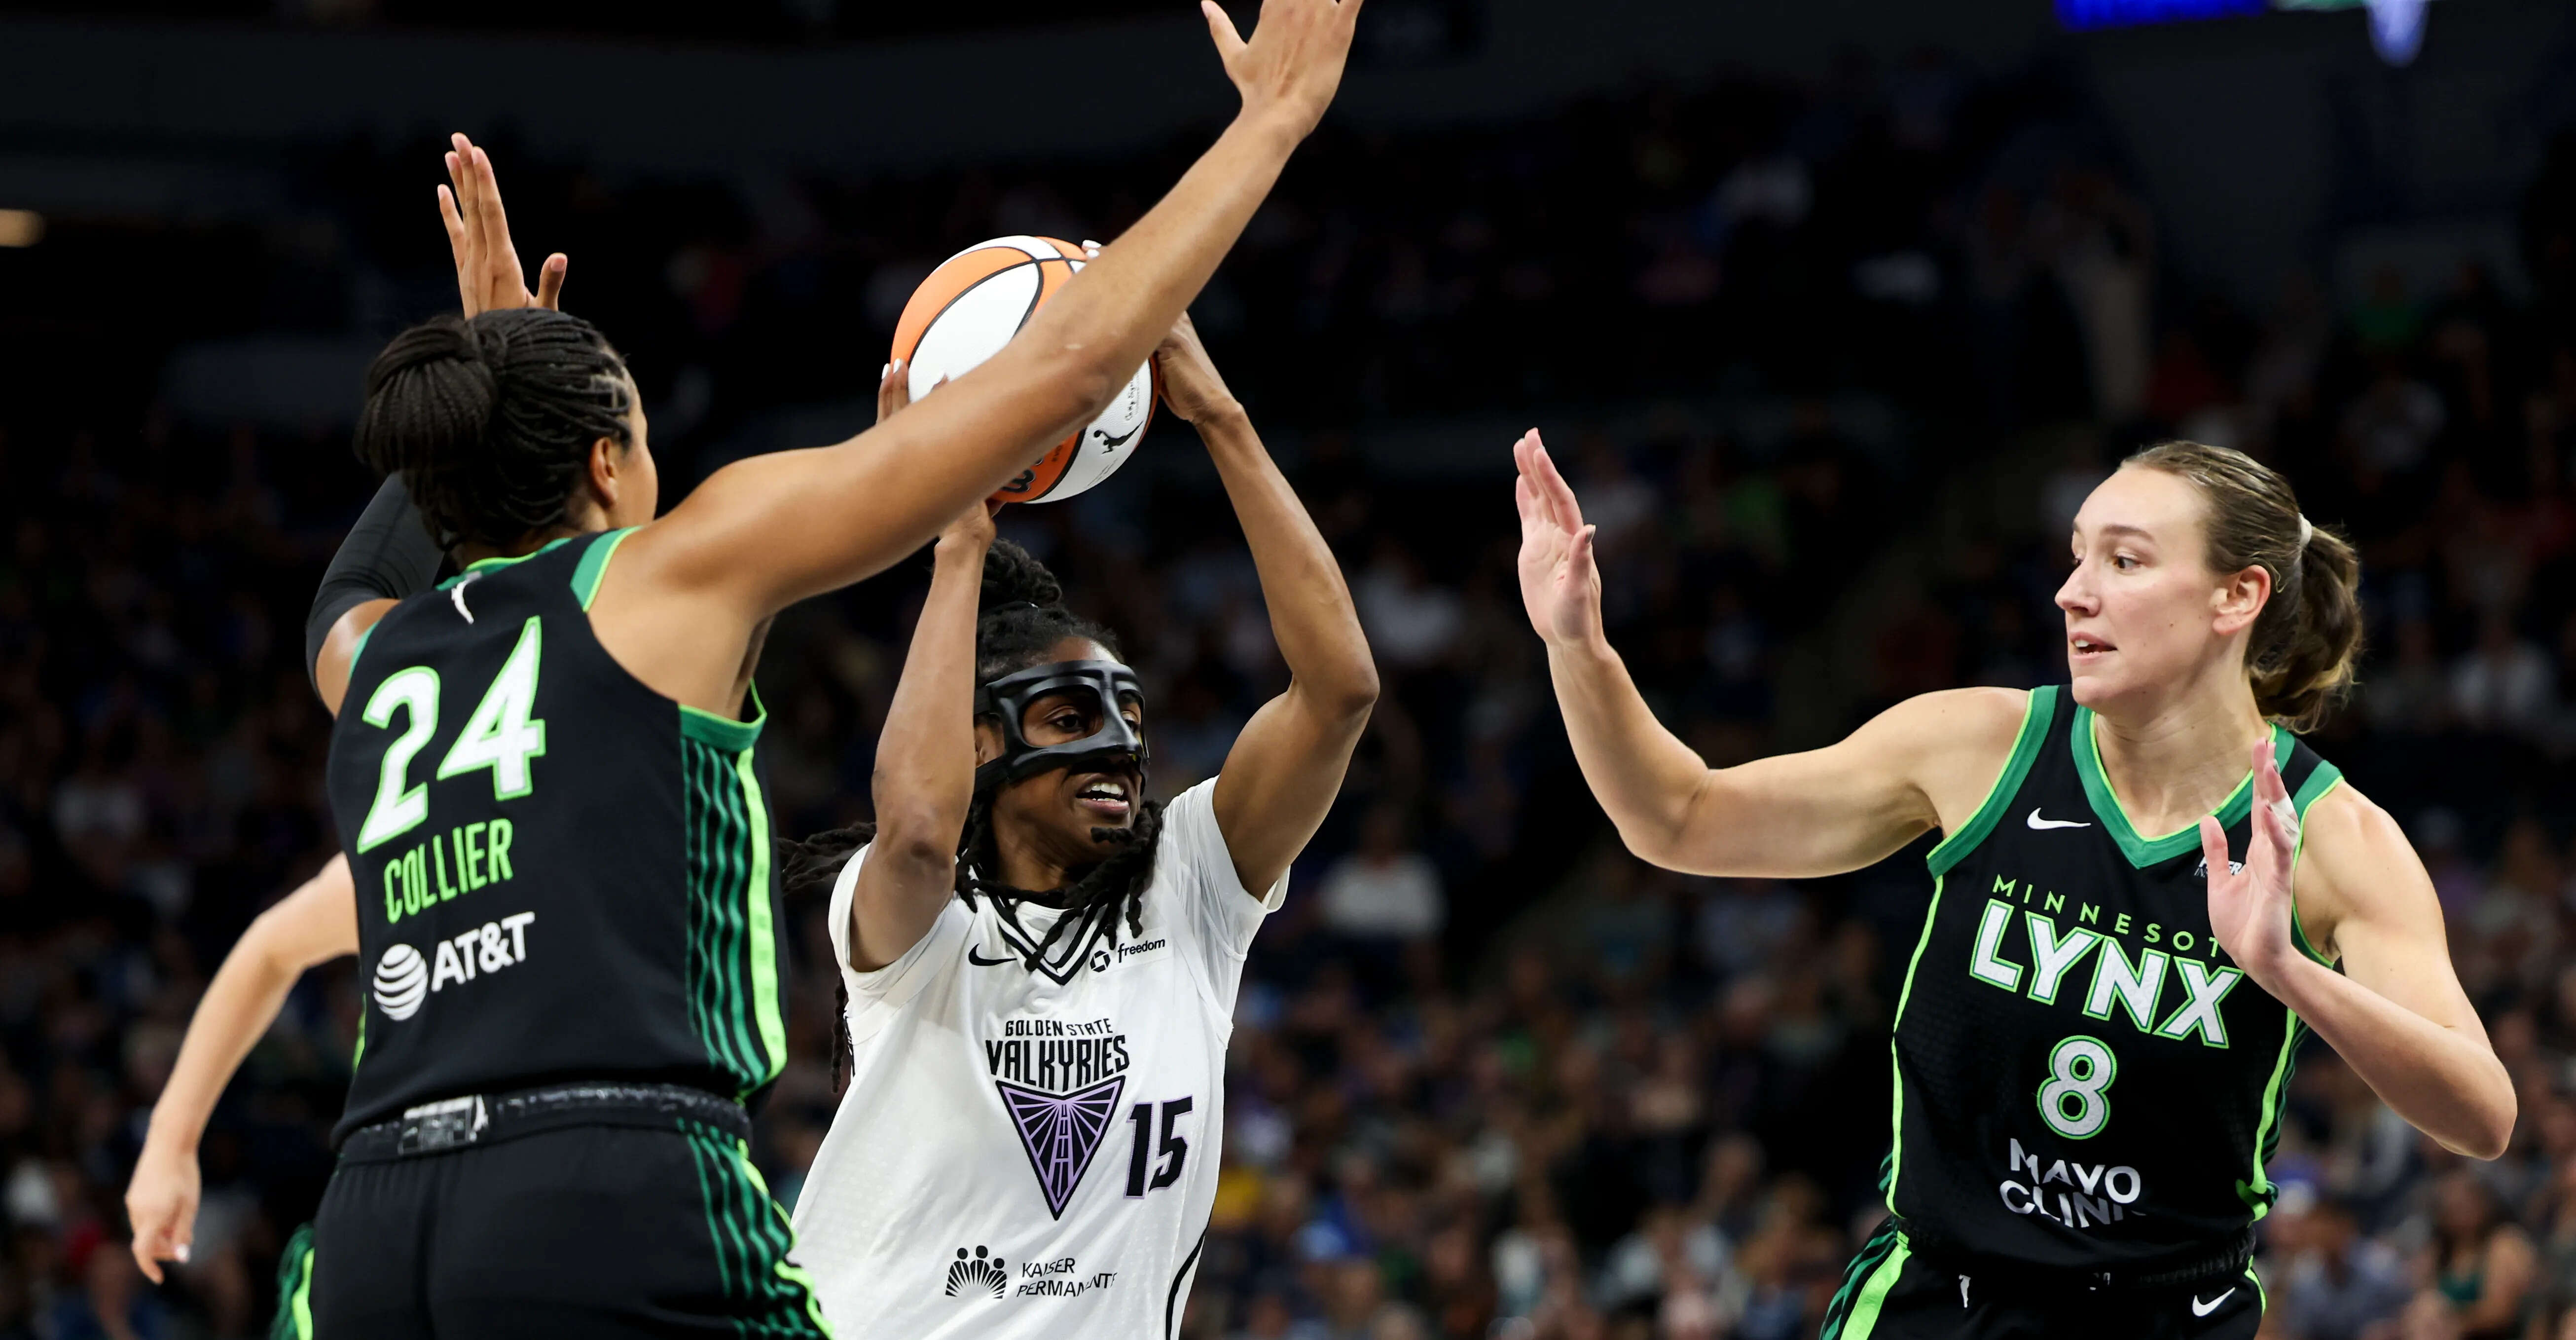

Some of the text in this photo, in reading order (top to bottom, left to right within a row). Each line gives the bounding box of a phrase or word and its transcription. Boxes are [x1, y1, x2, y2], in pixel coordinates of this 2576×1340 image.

[357, 615, 546, 855] 24
[383, 818, 514, 924] COLLIER
[431, 912, 536, 992] AT&T
[1118, 939, 1165, 963] freedom
[1993, 873, 2218, 957] MINNESOT
[1969, 898, 2244, 1049] LYNX
[985, 1034, 1130, 1092] VALKYRIES
[1006, 1018, 1113, 1037] GOLDEN STATE
[2037, 1035, 2118, 1140] 8
[1123, 1094, 1194, 1199] 15
[2009, 1137, 2141, 1204] MAYO
[1999, 1180, 2147, 1228] CLINI
[1022, 1258, 1076, 1278] KAISER
